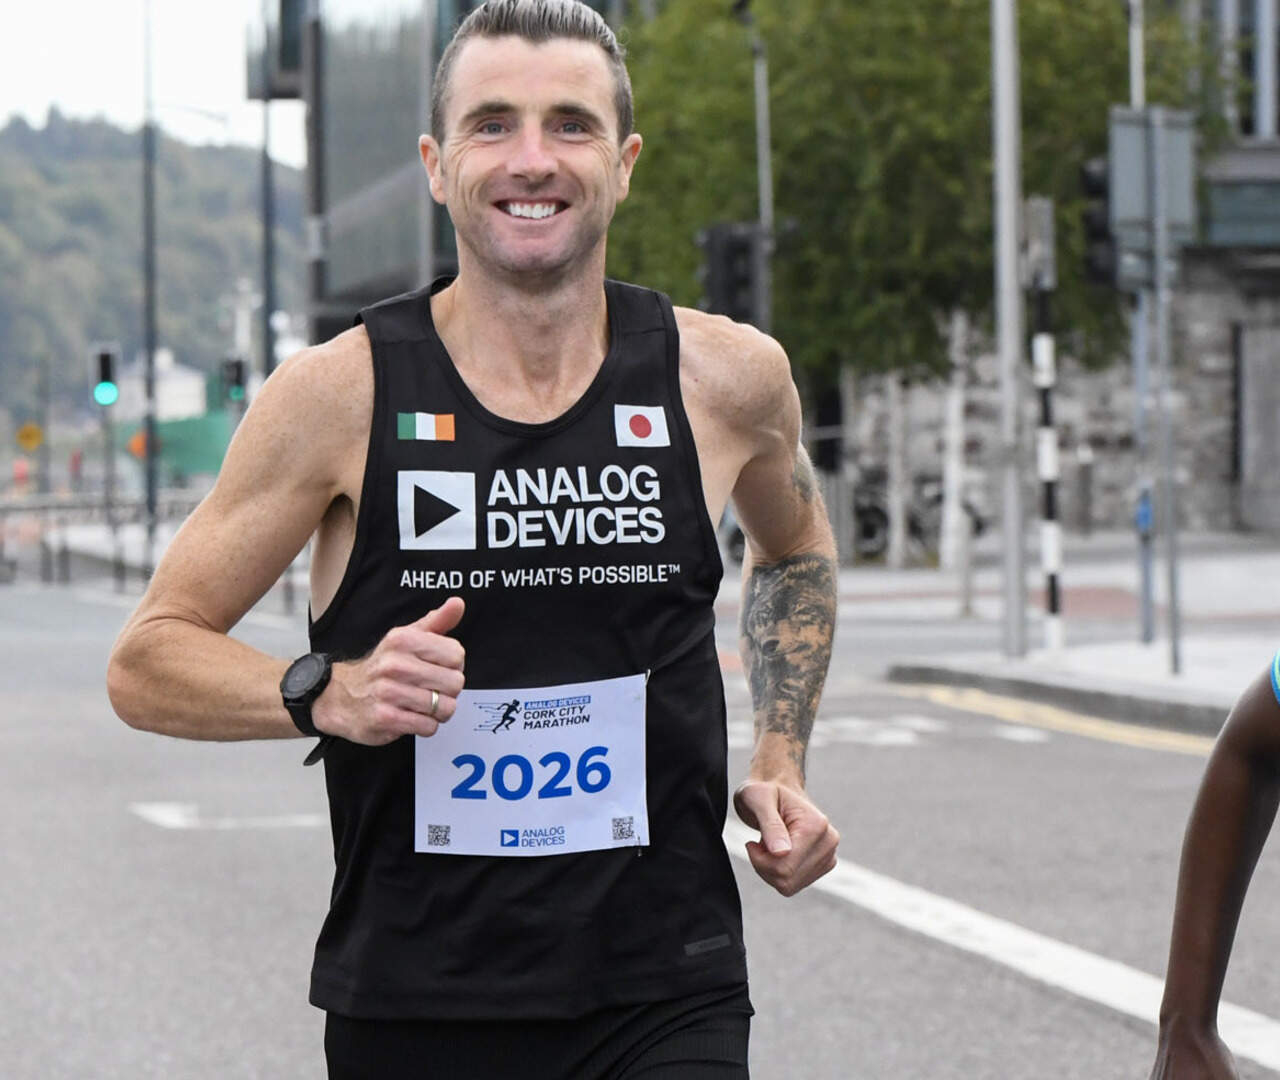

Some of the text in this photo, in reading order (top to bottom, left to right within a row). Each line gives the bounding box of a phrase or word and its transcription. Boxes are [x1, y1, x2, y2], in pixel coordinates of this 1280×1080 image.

[487, 464, 661, 506] ANALOG
[487, 506, 666, 549] DEVICES
[399, 569, 463, 589] AHEAD
[469, 569, 496, 589] OF
[500, 566, 573, 588] WHAT'S
[523, 705, 587, 721] CORK CITY
[523, 714, 591, 730] MARATHON
[451, 746, 612, 801] 2026
[522, 826, 565, 837] ANALOG
[521, 836, 565, 848] DEVICES
